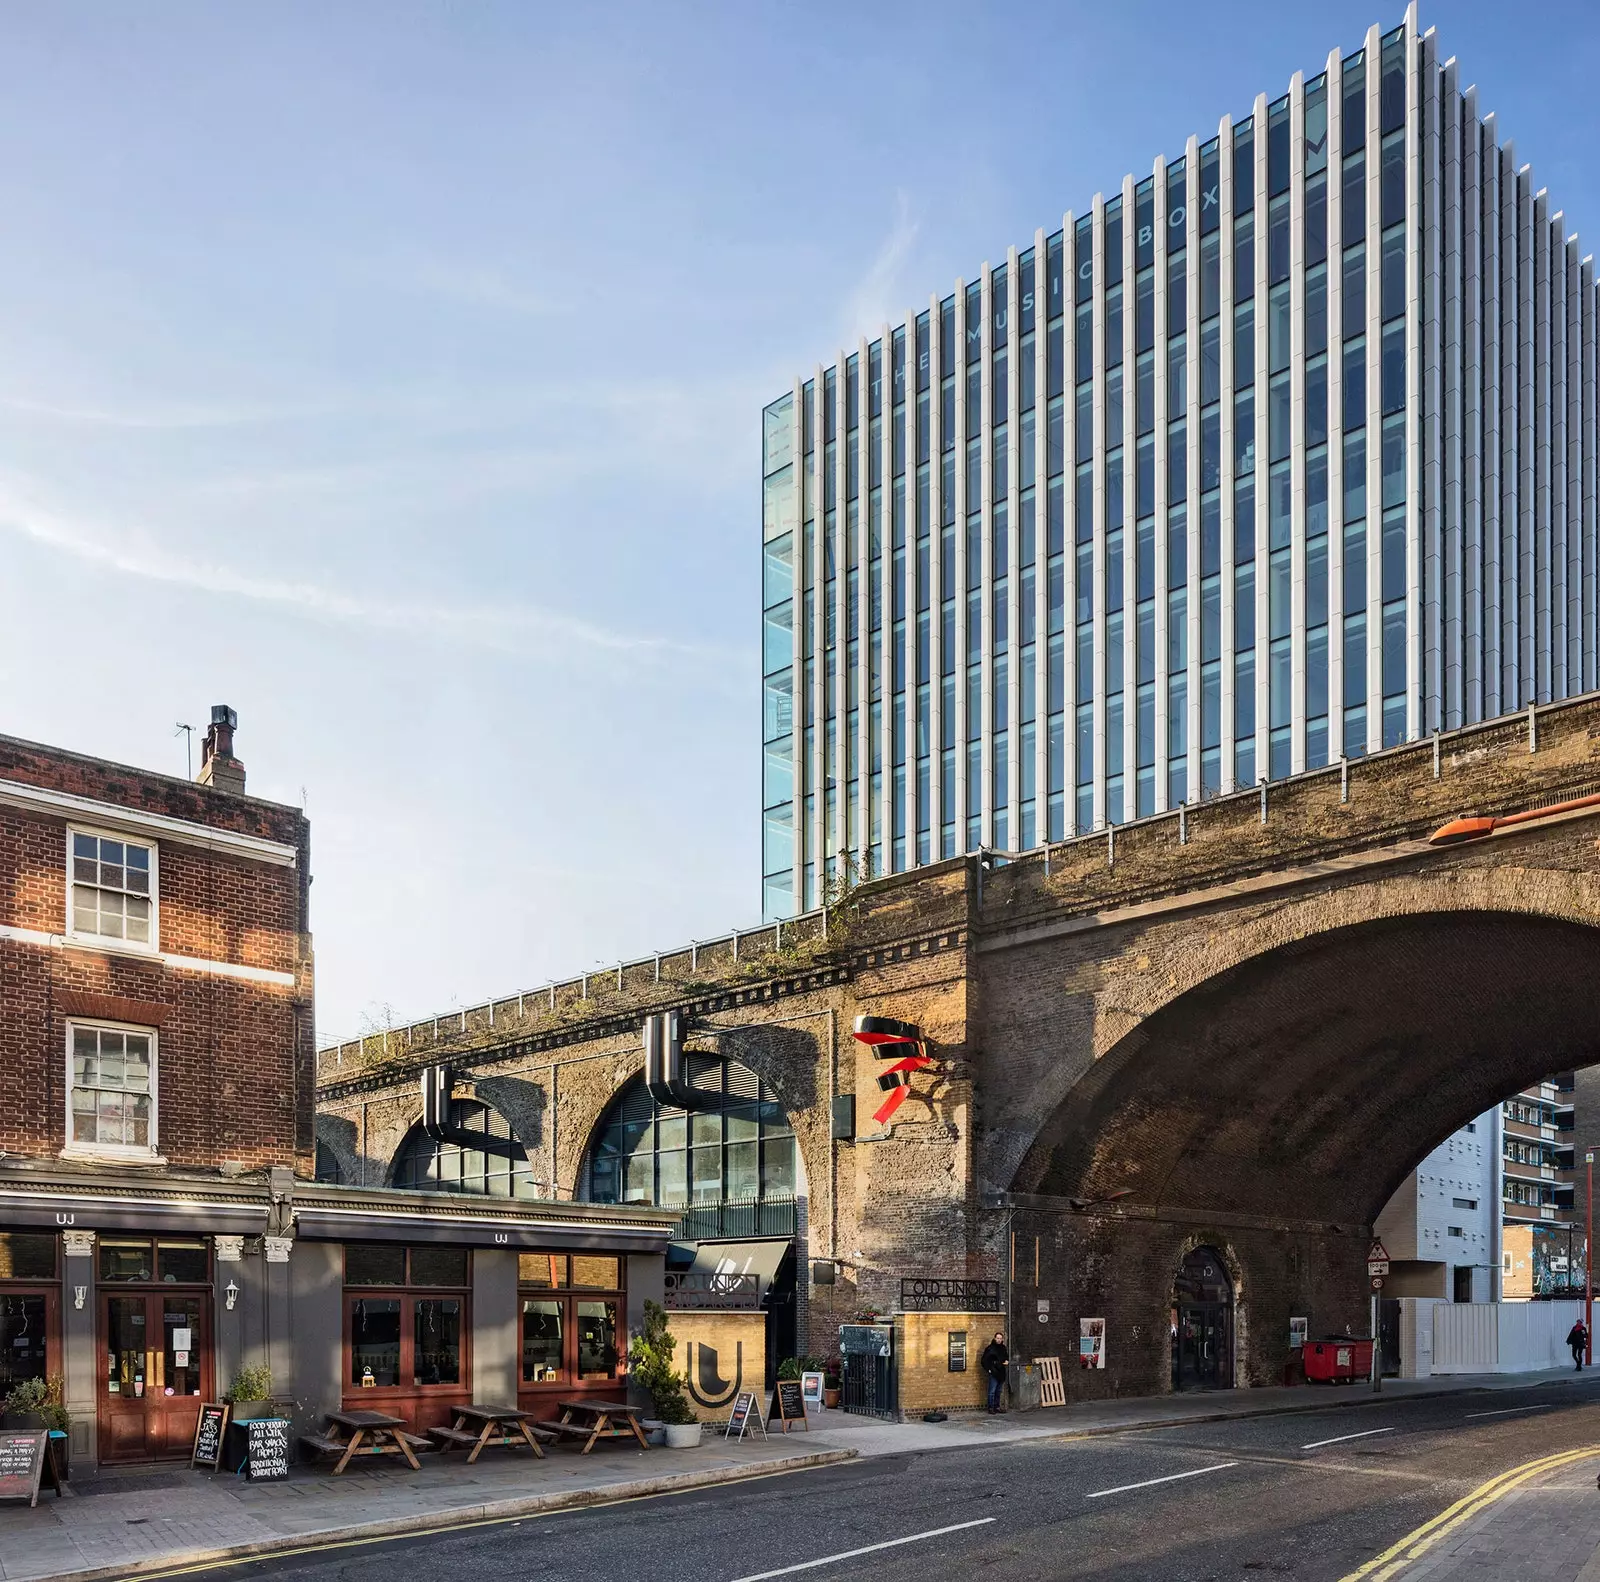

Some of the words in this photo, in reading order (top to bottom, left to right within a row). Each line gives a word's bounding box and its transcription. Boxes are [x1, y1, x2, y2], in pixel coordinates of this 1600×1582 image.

[871, 352, 929, 396] THE
[967, 260, 1093, 344] MUSIC
[1138, 185, 1219, 247] BOX
[56, 1213, 75, 1225] UJ
[495, 1234, 508, 1243] UJ
[913, 1280, 940, 1295] OLD
[946, 1281, 988, 1296] UNION
[249, 1421, 265, 1430] FOOD
[266, 1420, 288, 1430] SERVED
[253, 1429, 265, 1438] ALL
[265, 1428, 287, 1440] WEEK
[249, 1440, 264, 1452] BAR
[264, 1438, 288, 1448] SNACKS
[257, 1448, 273, 1458] FROM
[250, 1458, 288, 1470] TRADITIONAL
[250, 1467, 271, 1478] SUNDAY
[271, 1465, 288, 1476] ROAST
